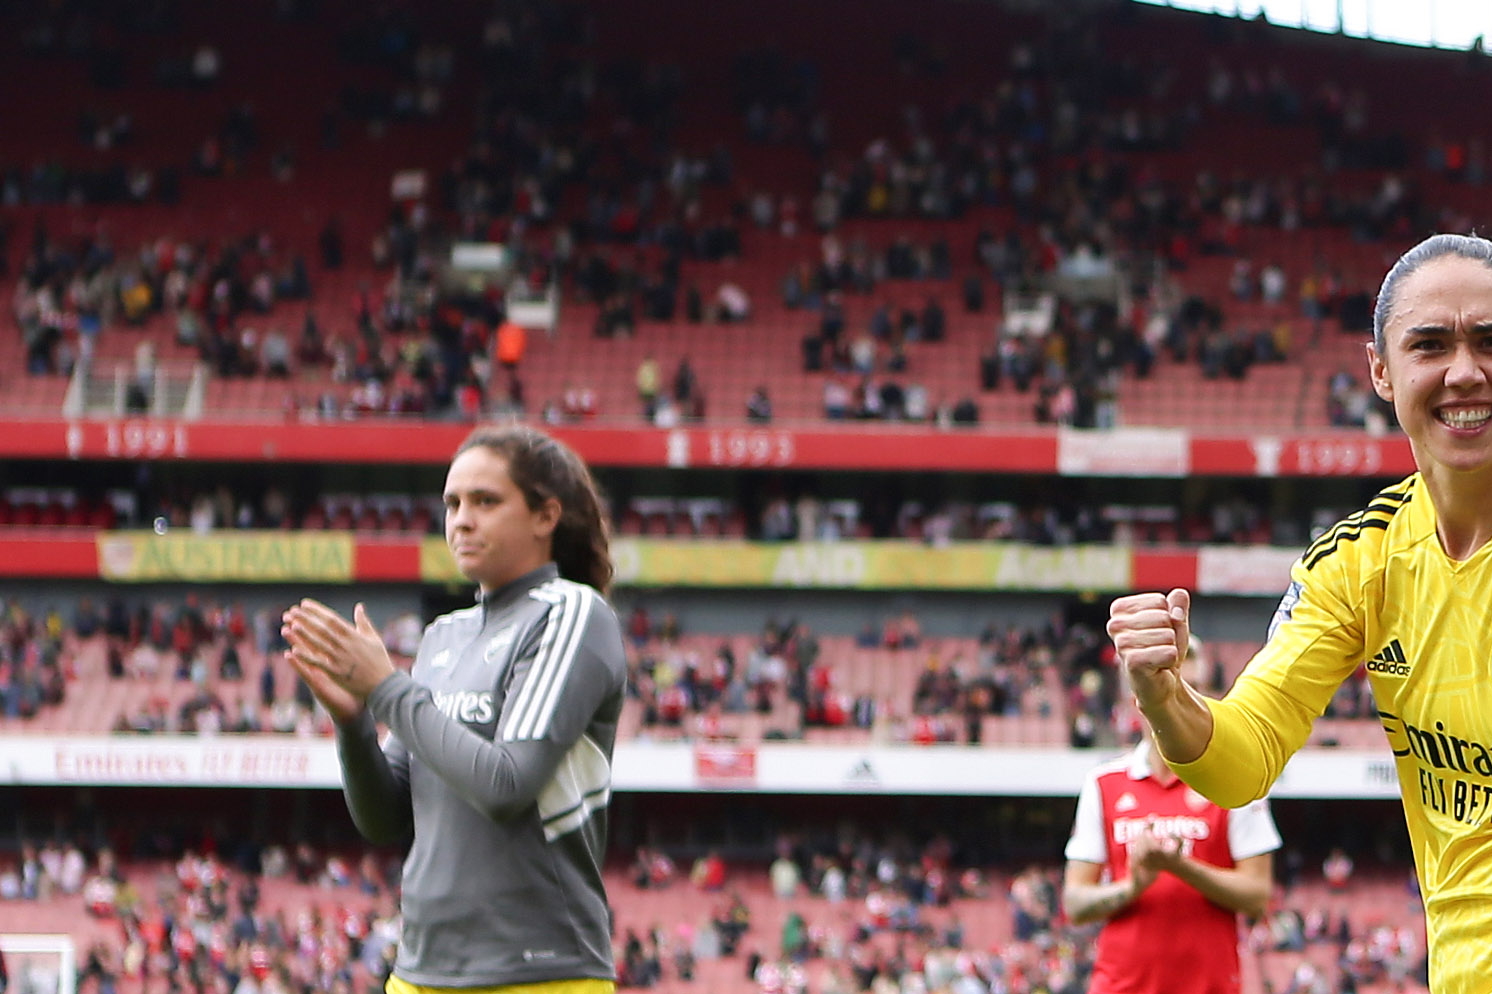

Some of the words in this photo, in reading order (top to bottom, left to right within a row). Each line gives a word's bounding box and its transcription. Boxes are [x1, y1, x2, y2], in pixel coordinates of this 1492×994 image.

[138, 539, 346, 574] AUSTRALIA
[771, 546, 867, 586] AND
[996, 550, 1131, 590] AGAIN
[1367, 660, 1410, 676] adidas
[1418, 767, 1447, 814] FLY
